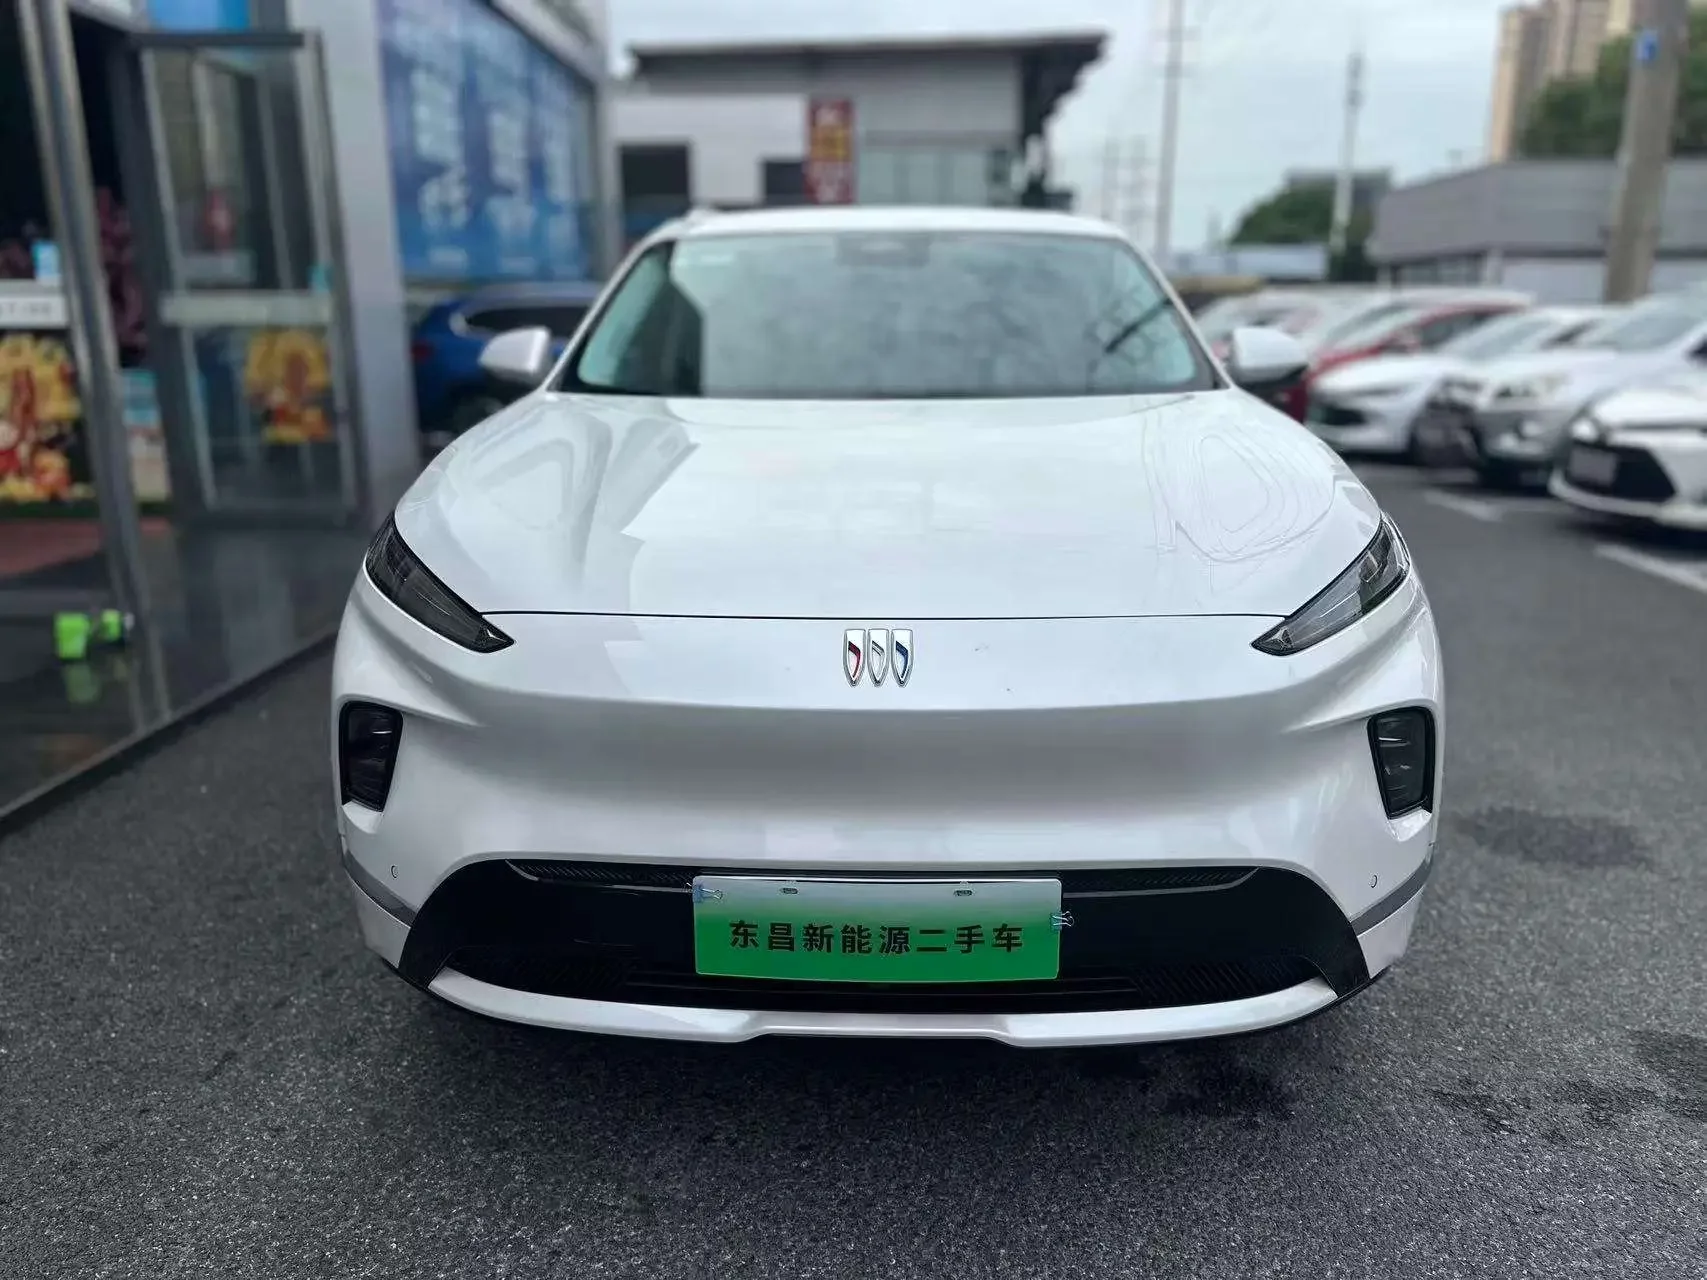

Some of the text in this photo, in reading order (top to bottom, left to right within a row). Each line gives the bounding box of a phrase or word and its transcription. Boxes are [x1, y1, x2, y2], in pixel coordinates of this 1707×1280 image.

[729, 919, 1024, 954] 东昌新能源二手车
